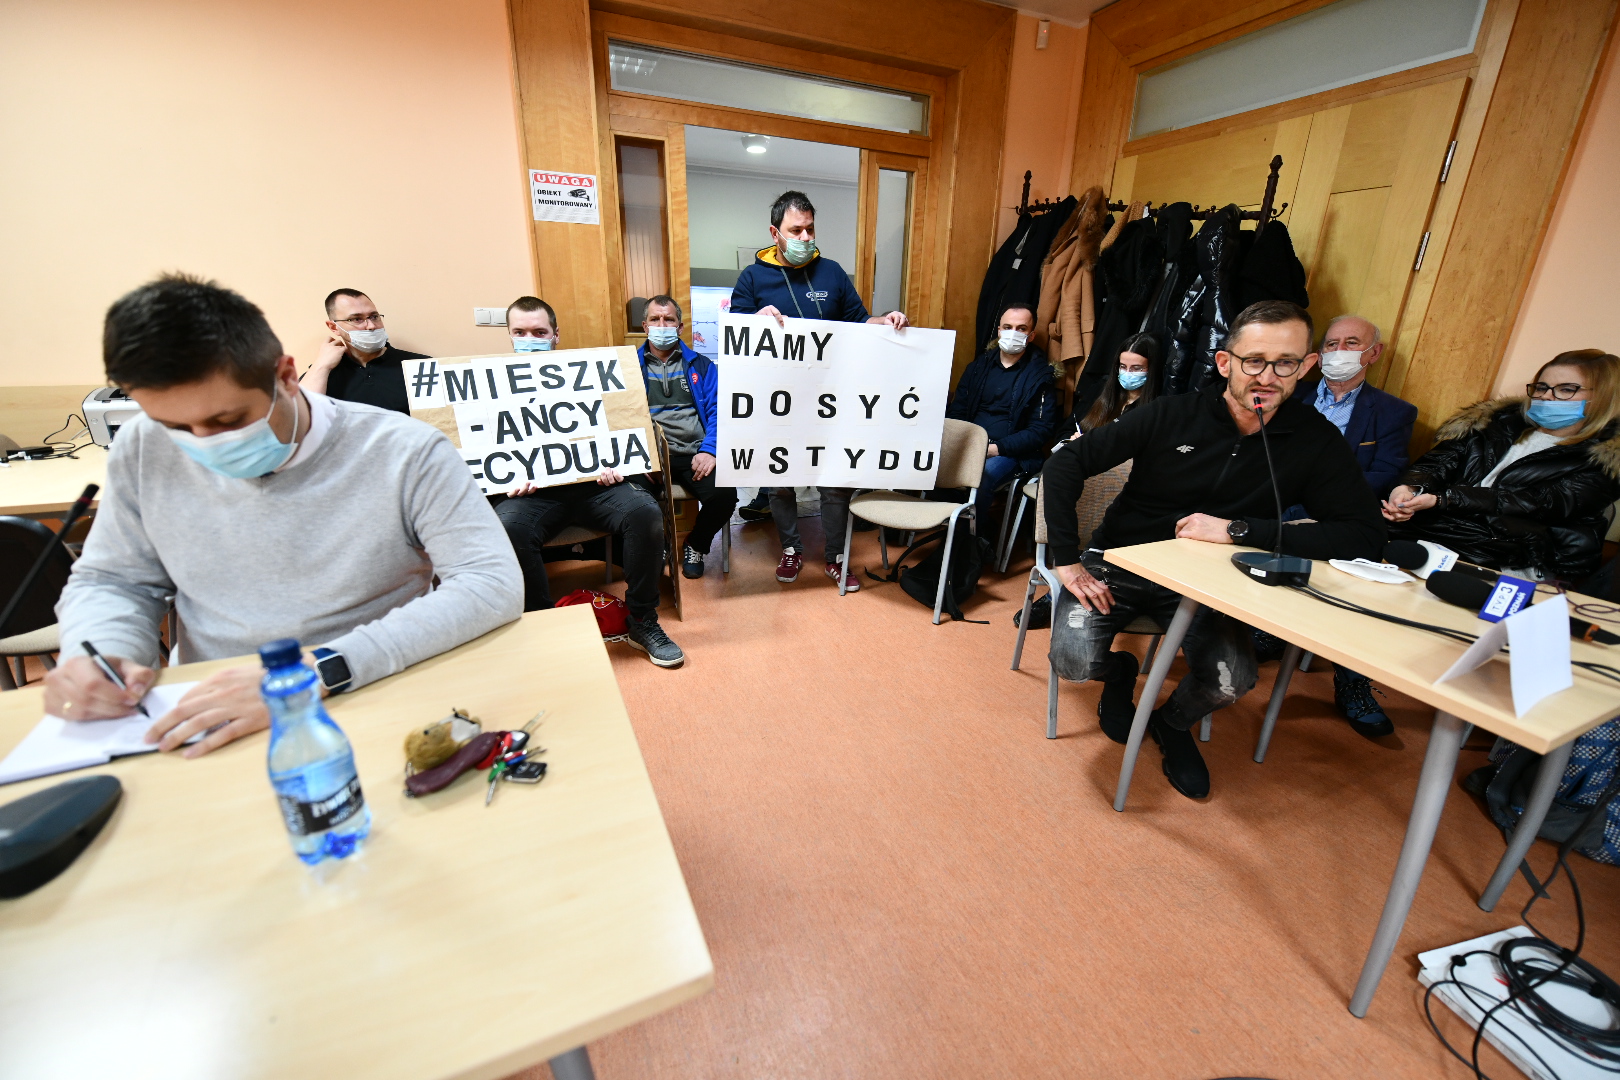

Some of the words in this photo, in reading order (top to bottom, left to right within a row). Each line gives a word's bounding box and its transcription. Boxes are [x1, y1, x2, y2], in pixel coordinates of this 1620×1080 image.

[536, 174, 591, 186] UWAGA
[538, 199, 593, 208] MONITOROWANY
[724, 325, 833, 361] MAMY
[731, 446, 934, 474] WSTYDU
